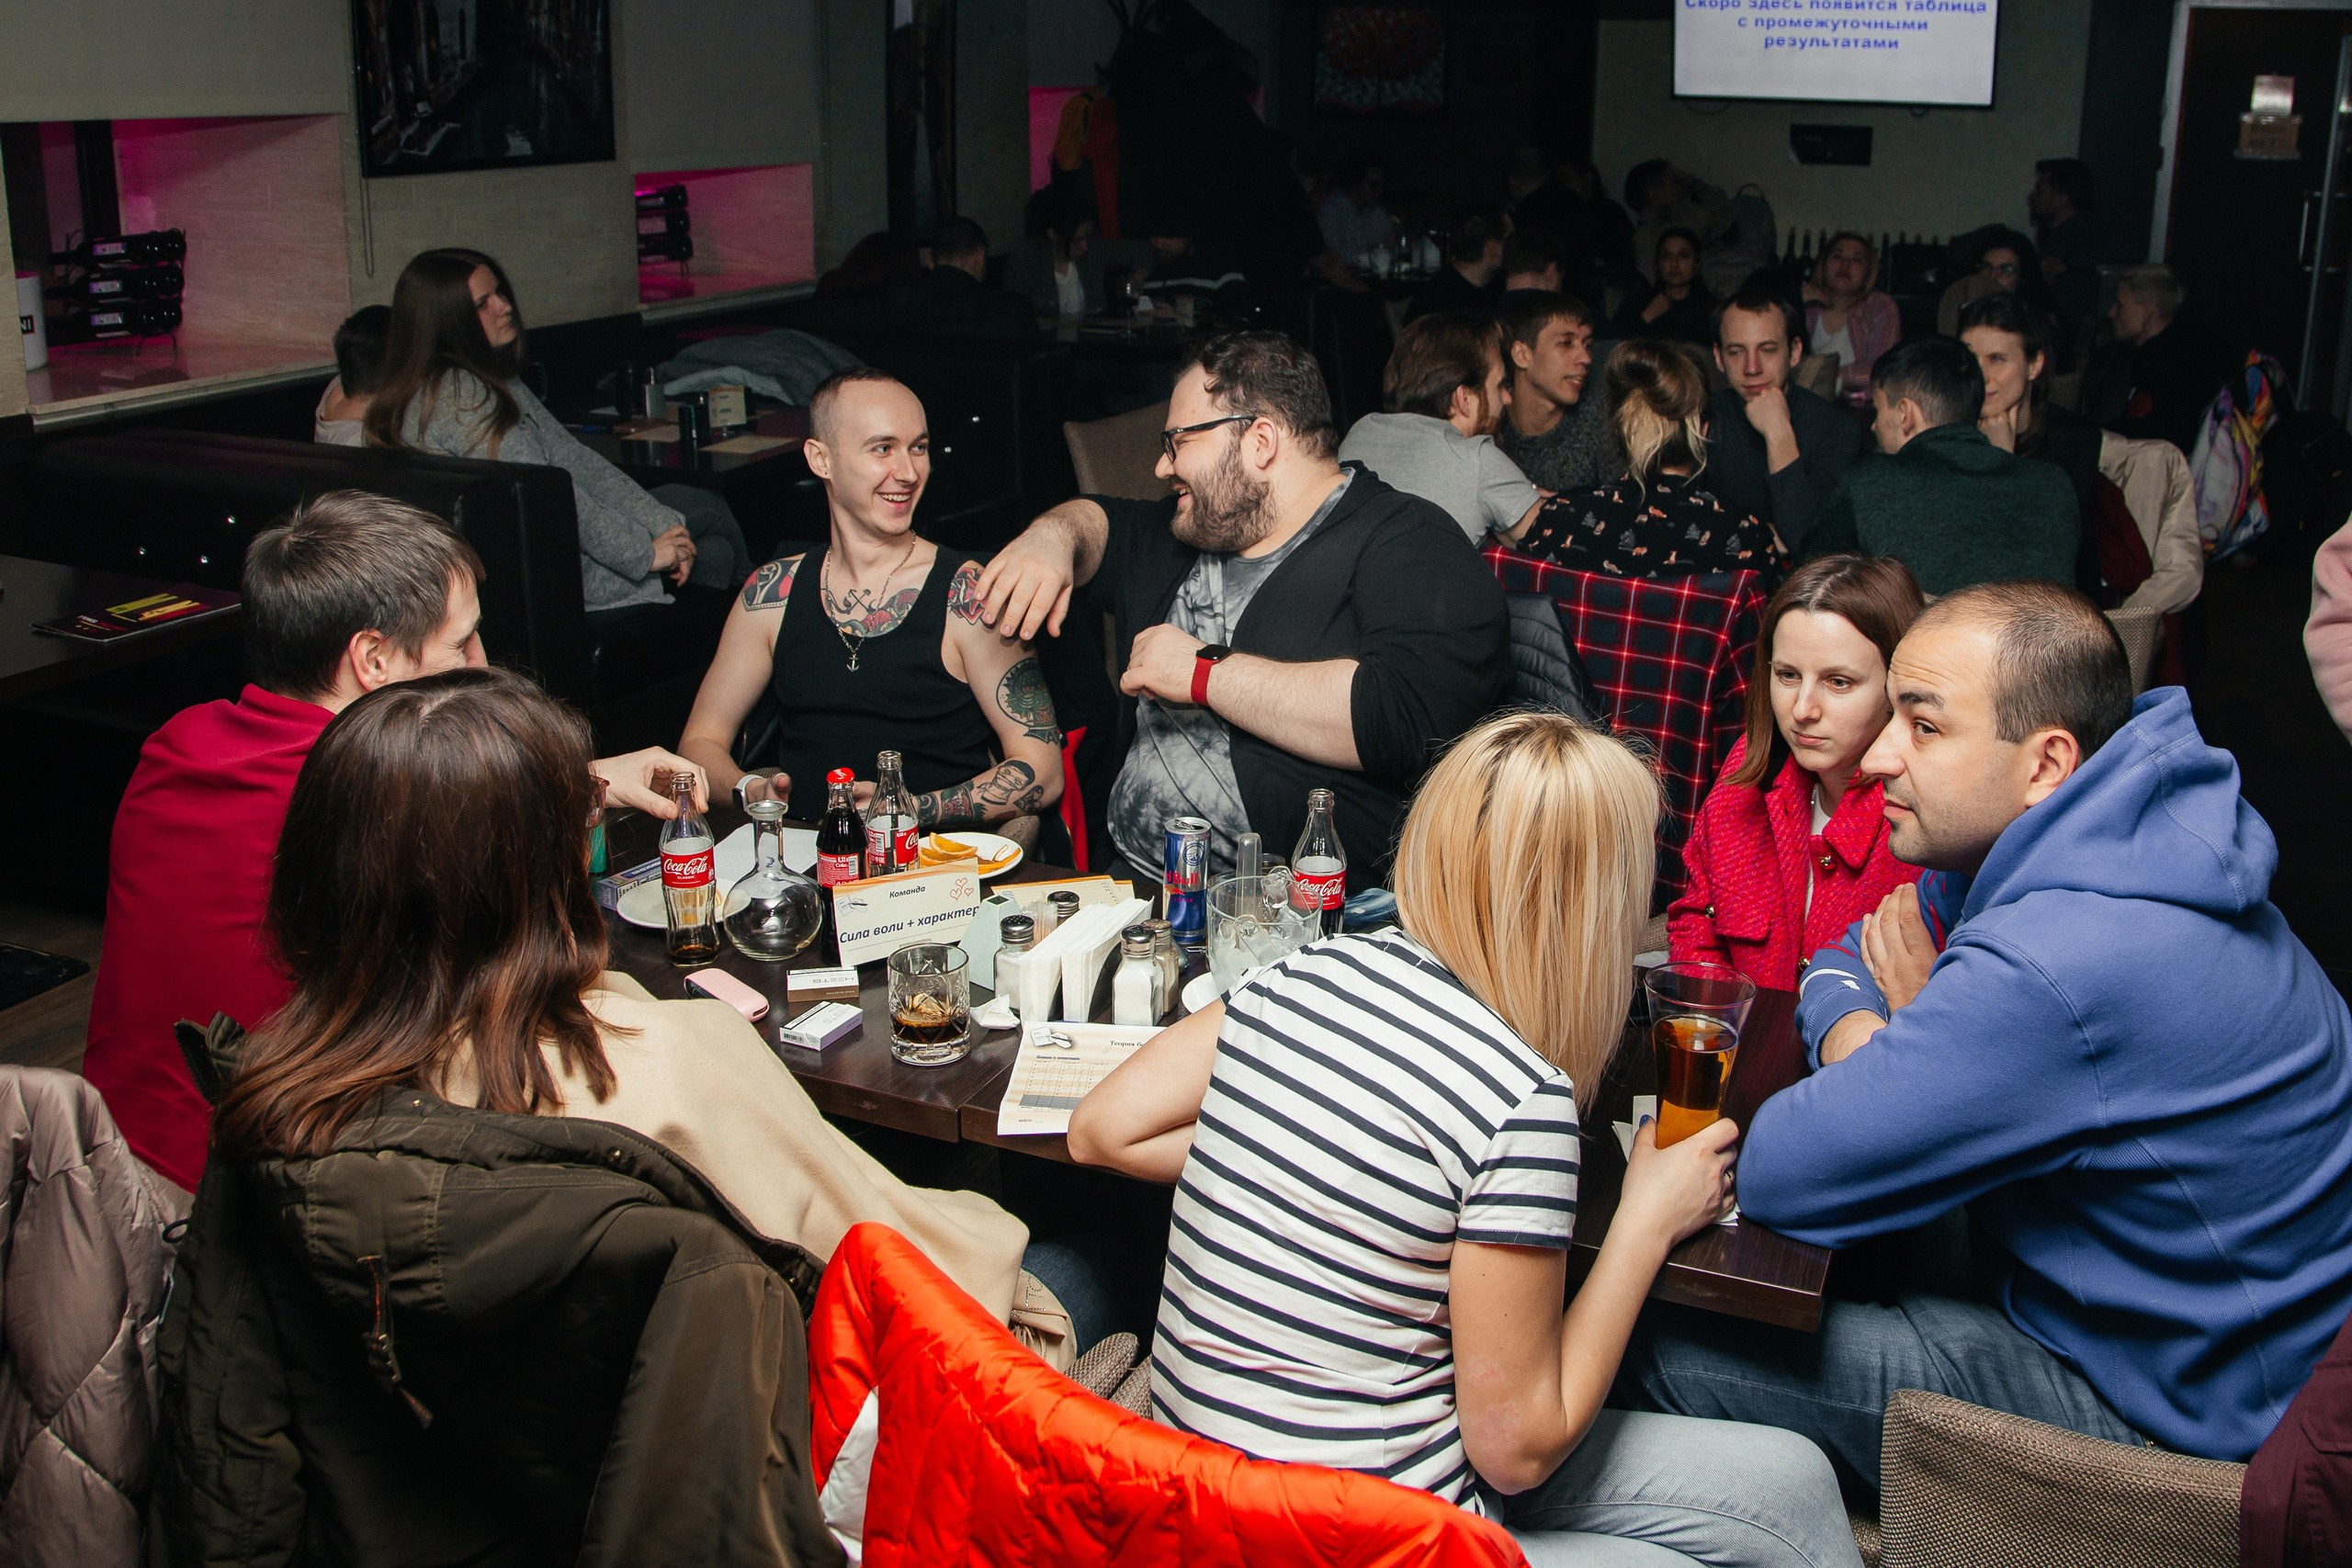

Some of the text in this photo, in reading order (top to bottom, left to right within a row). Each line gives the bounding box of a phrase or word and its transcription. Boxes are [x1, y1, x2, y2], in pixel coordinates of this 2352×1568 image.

[1685, 0, 1987, 13] Скоро здесь появится таблица
[1737, 17, 1928, 31] с промежуточными
[1764, 37, 1899, 50] результатами
[663, 855, 708, 875] Coca-Cola
[1172, 872, 1198, 886] Bull
[889, 886, 926, 898] Команда
[840, 906, 979, 943] Сила воли + характер
